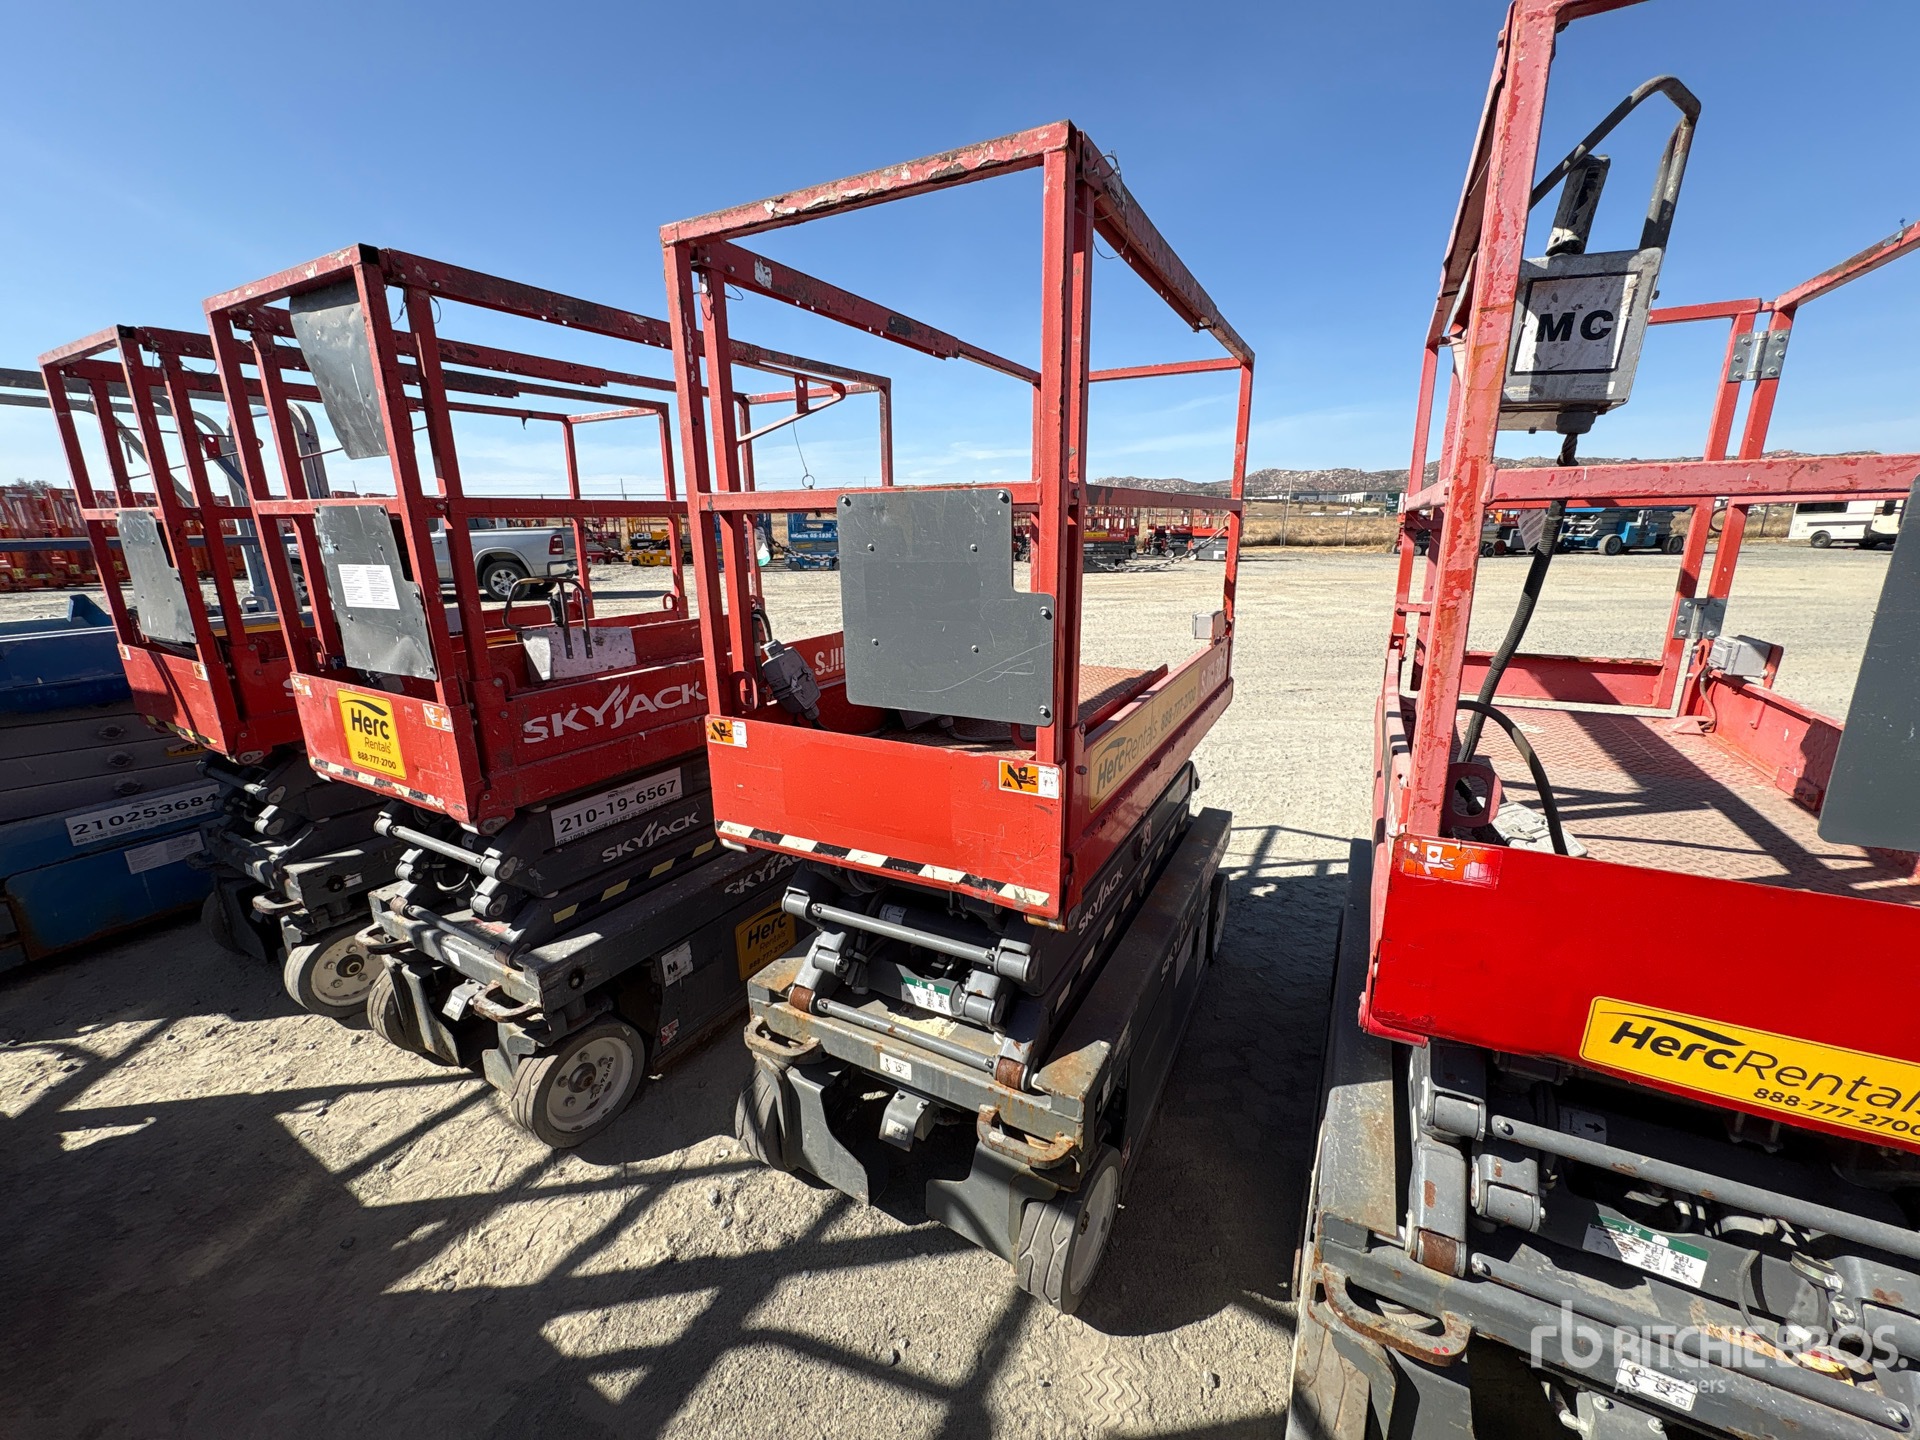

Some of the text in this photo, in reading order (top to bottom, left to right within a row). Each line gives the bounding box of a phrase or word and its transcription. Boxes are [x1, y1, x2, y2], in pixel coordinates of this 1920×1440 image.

[1534, 309, 1614, 342] MC
[630, 532, 652, 540] JCB
[350, 707, 390, 740] Herc
[523, 680, 707, 744] SKYJACK
[357, 751, 397, 770] 888-777-2700
[364, 737, 392, 754] Rentals
[72, 792, 219, 836] 210253684
[559, 779, 677, 834] 210-19-6567
[602, 810, 700, 863] SKYJACK
[724, 852, 803, 895] SKYJA
[1078, 864, 1124, 936] SKYJACK
[747, 913, 788, 950] Herc
[667, 960, 679, 975] M
[1608, 1020, 1920, 1115] HercRental
[1752, 1087, 1920, 1138] 888-777-2700
